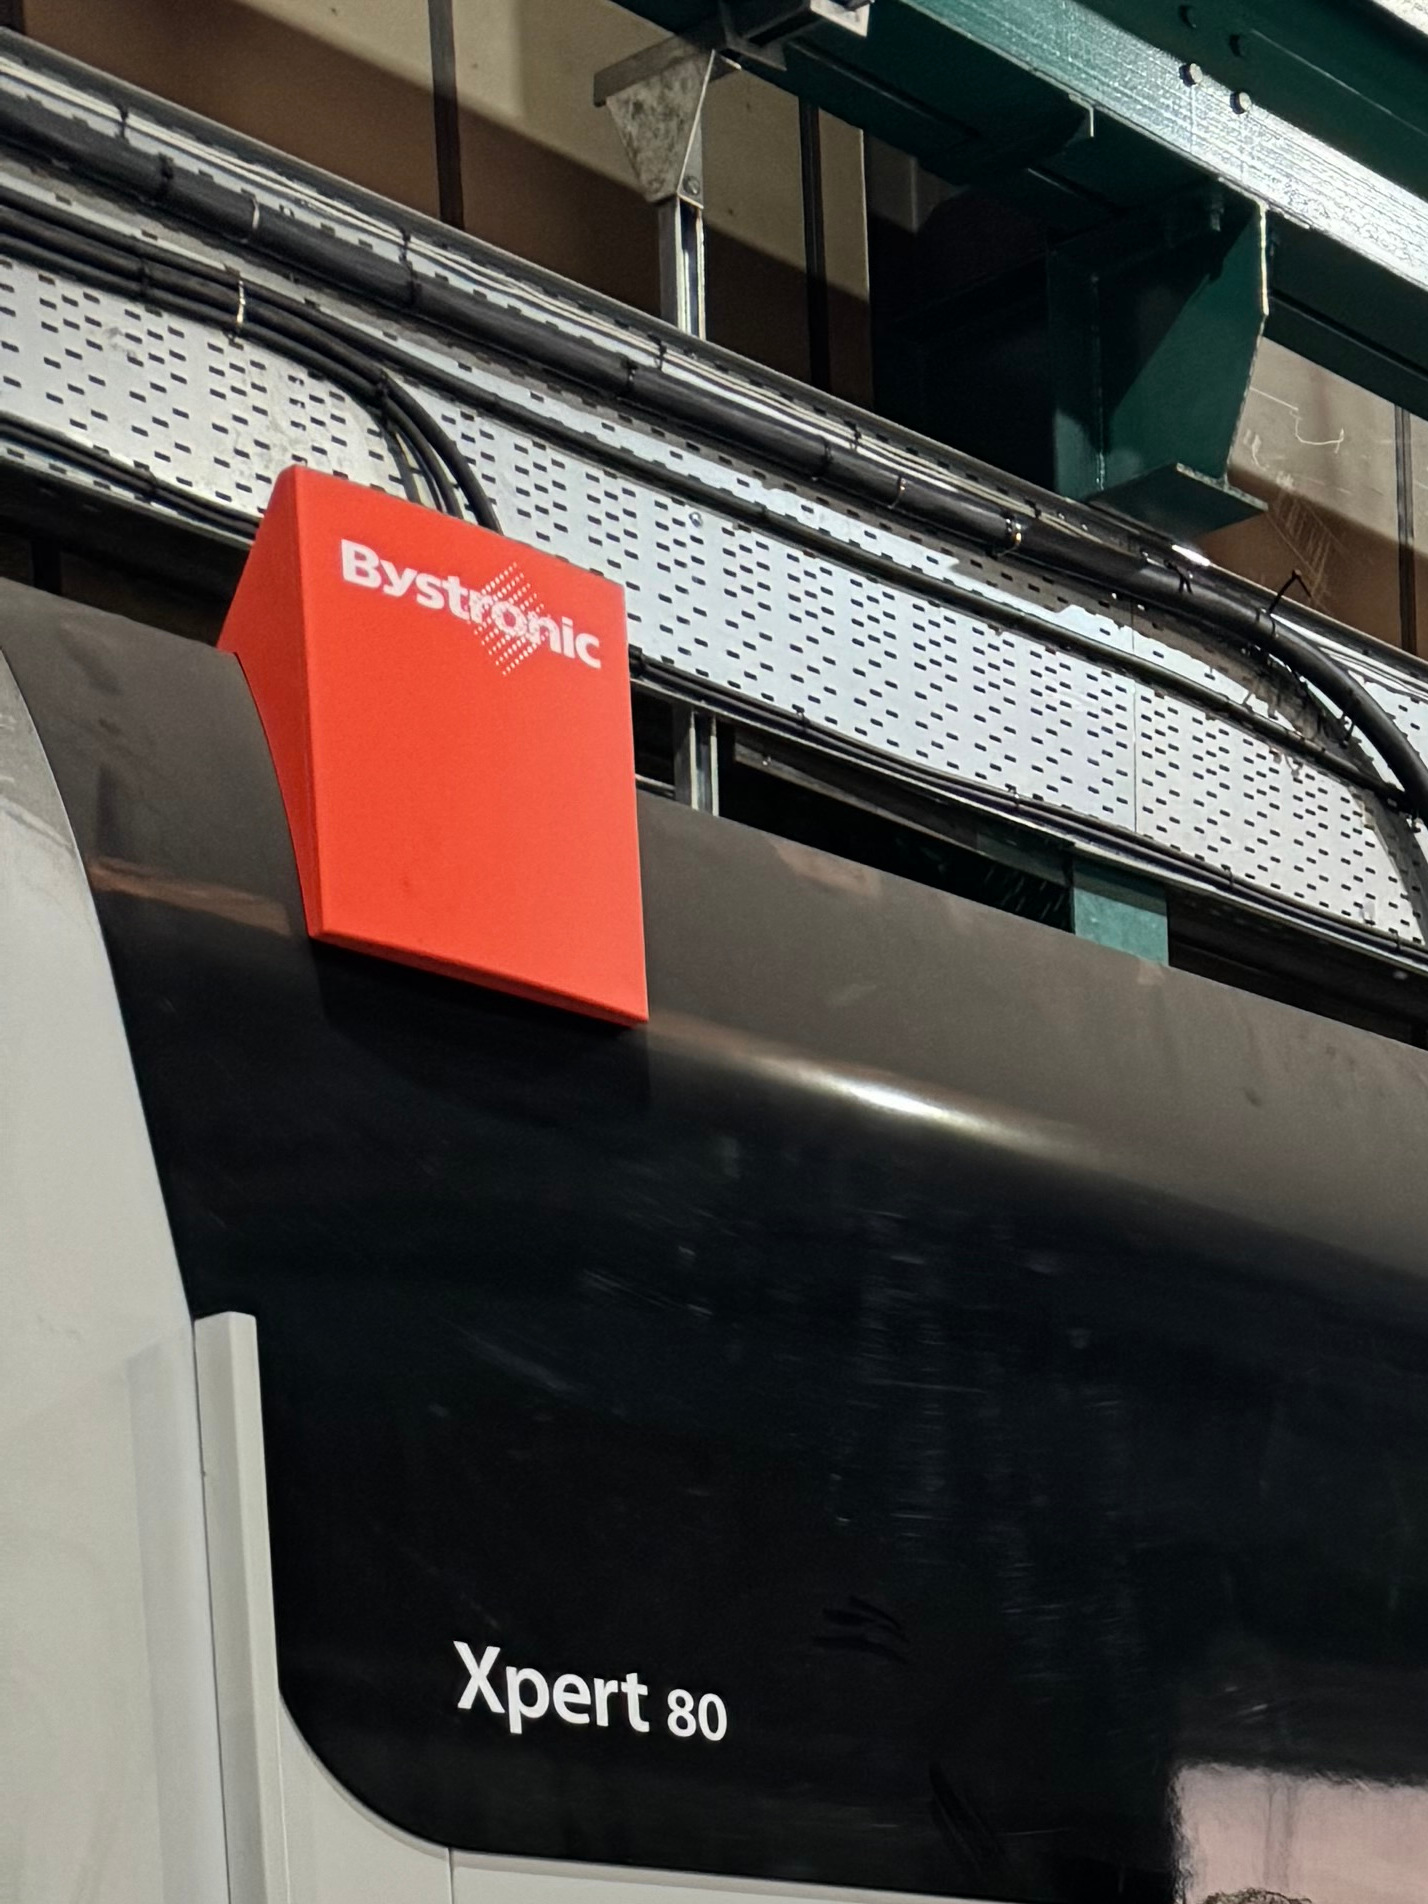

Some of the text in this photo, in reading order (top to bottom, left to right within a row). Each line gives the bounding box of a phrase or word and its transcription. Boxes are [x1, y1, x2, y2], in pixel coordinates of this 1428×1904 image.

[340, 538, 601, 670] Bystronic
[453, 1640, 728, 1742] Xpert 80
